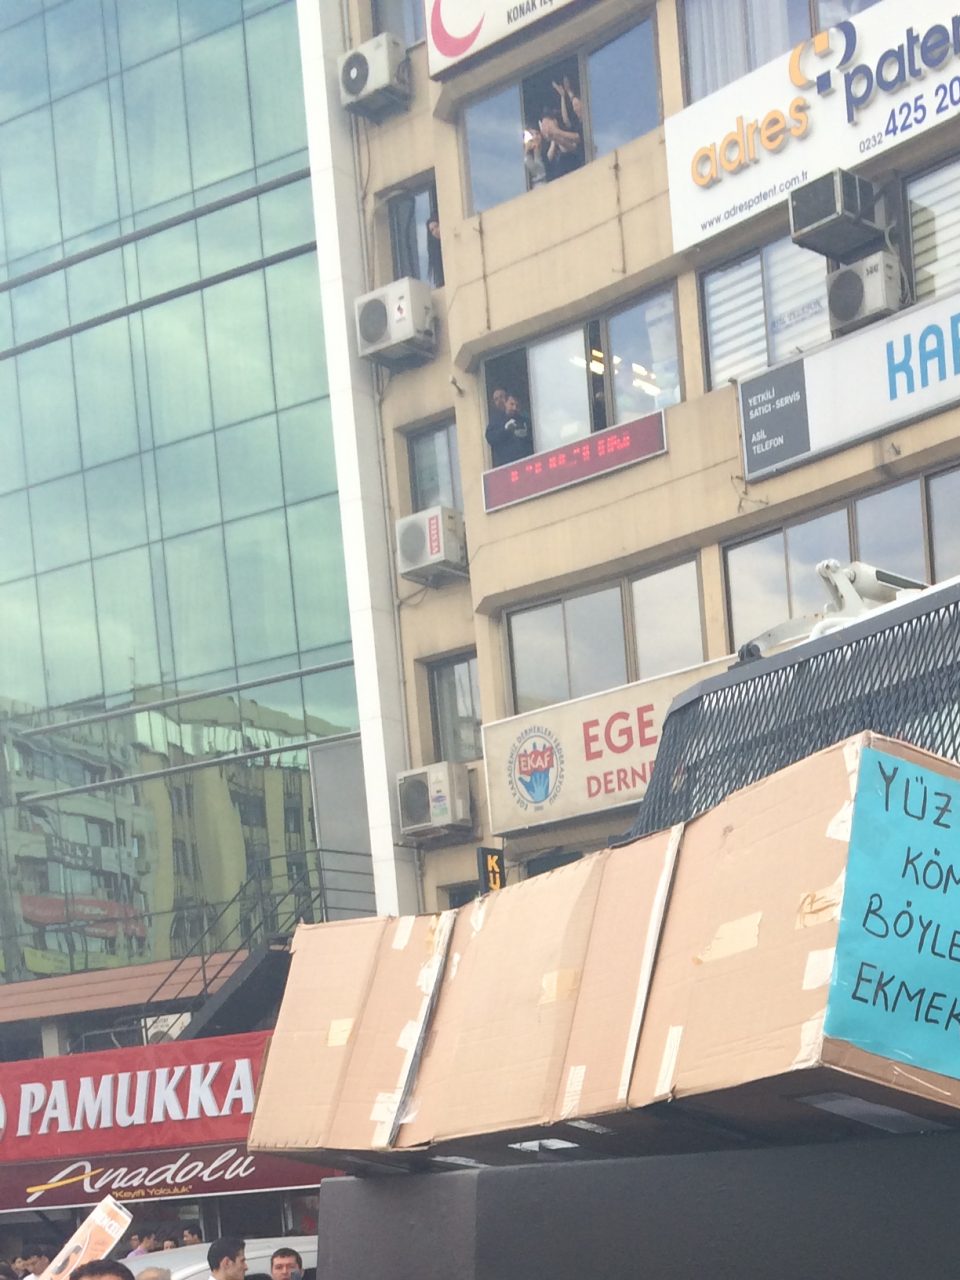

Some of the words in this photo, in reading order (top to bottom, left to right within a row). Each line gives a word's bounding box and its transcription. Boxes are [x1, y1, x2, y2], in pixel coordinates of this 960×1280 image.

[506, 0, 537, 24] KONAK
[691, 97, 811, 189] adres
[859, 132, 884, 153] 0232
[884, 96, 927, 137] 425
[700, 170, 808, 231] www.adrespatent.com.tr
[748, 387, 775, 406] YETKİLİ
[749, 404, 772, 420] SATICI
[776, 391, 801, 409] SERVİS
[752, 435, 784, 455] TELEFON
[583, 704, 658, 762] EGE
[518, 753, 551, 774] EKAF
[878, 761, 952, 829] YÜZ
[15, 1058, 255, 1138] PAMUKKA
[26, 1148, 256, 1203] Anadolu
